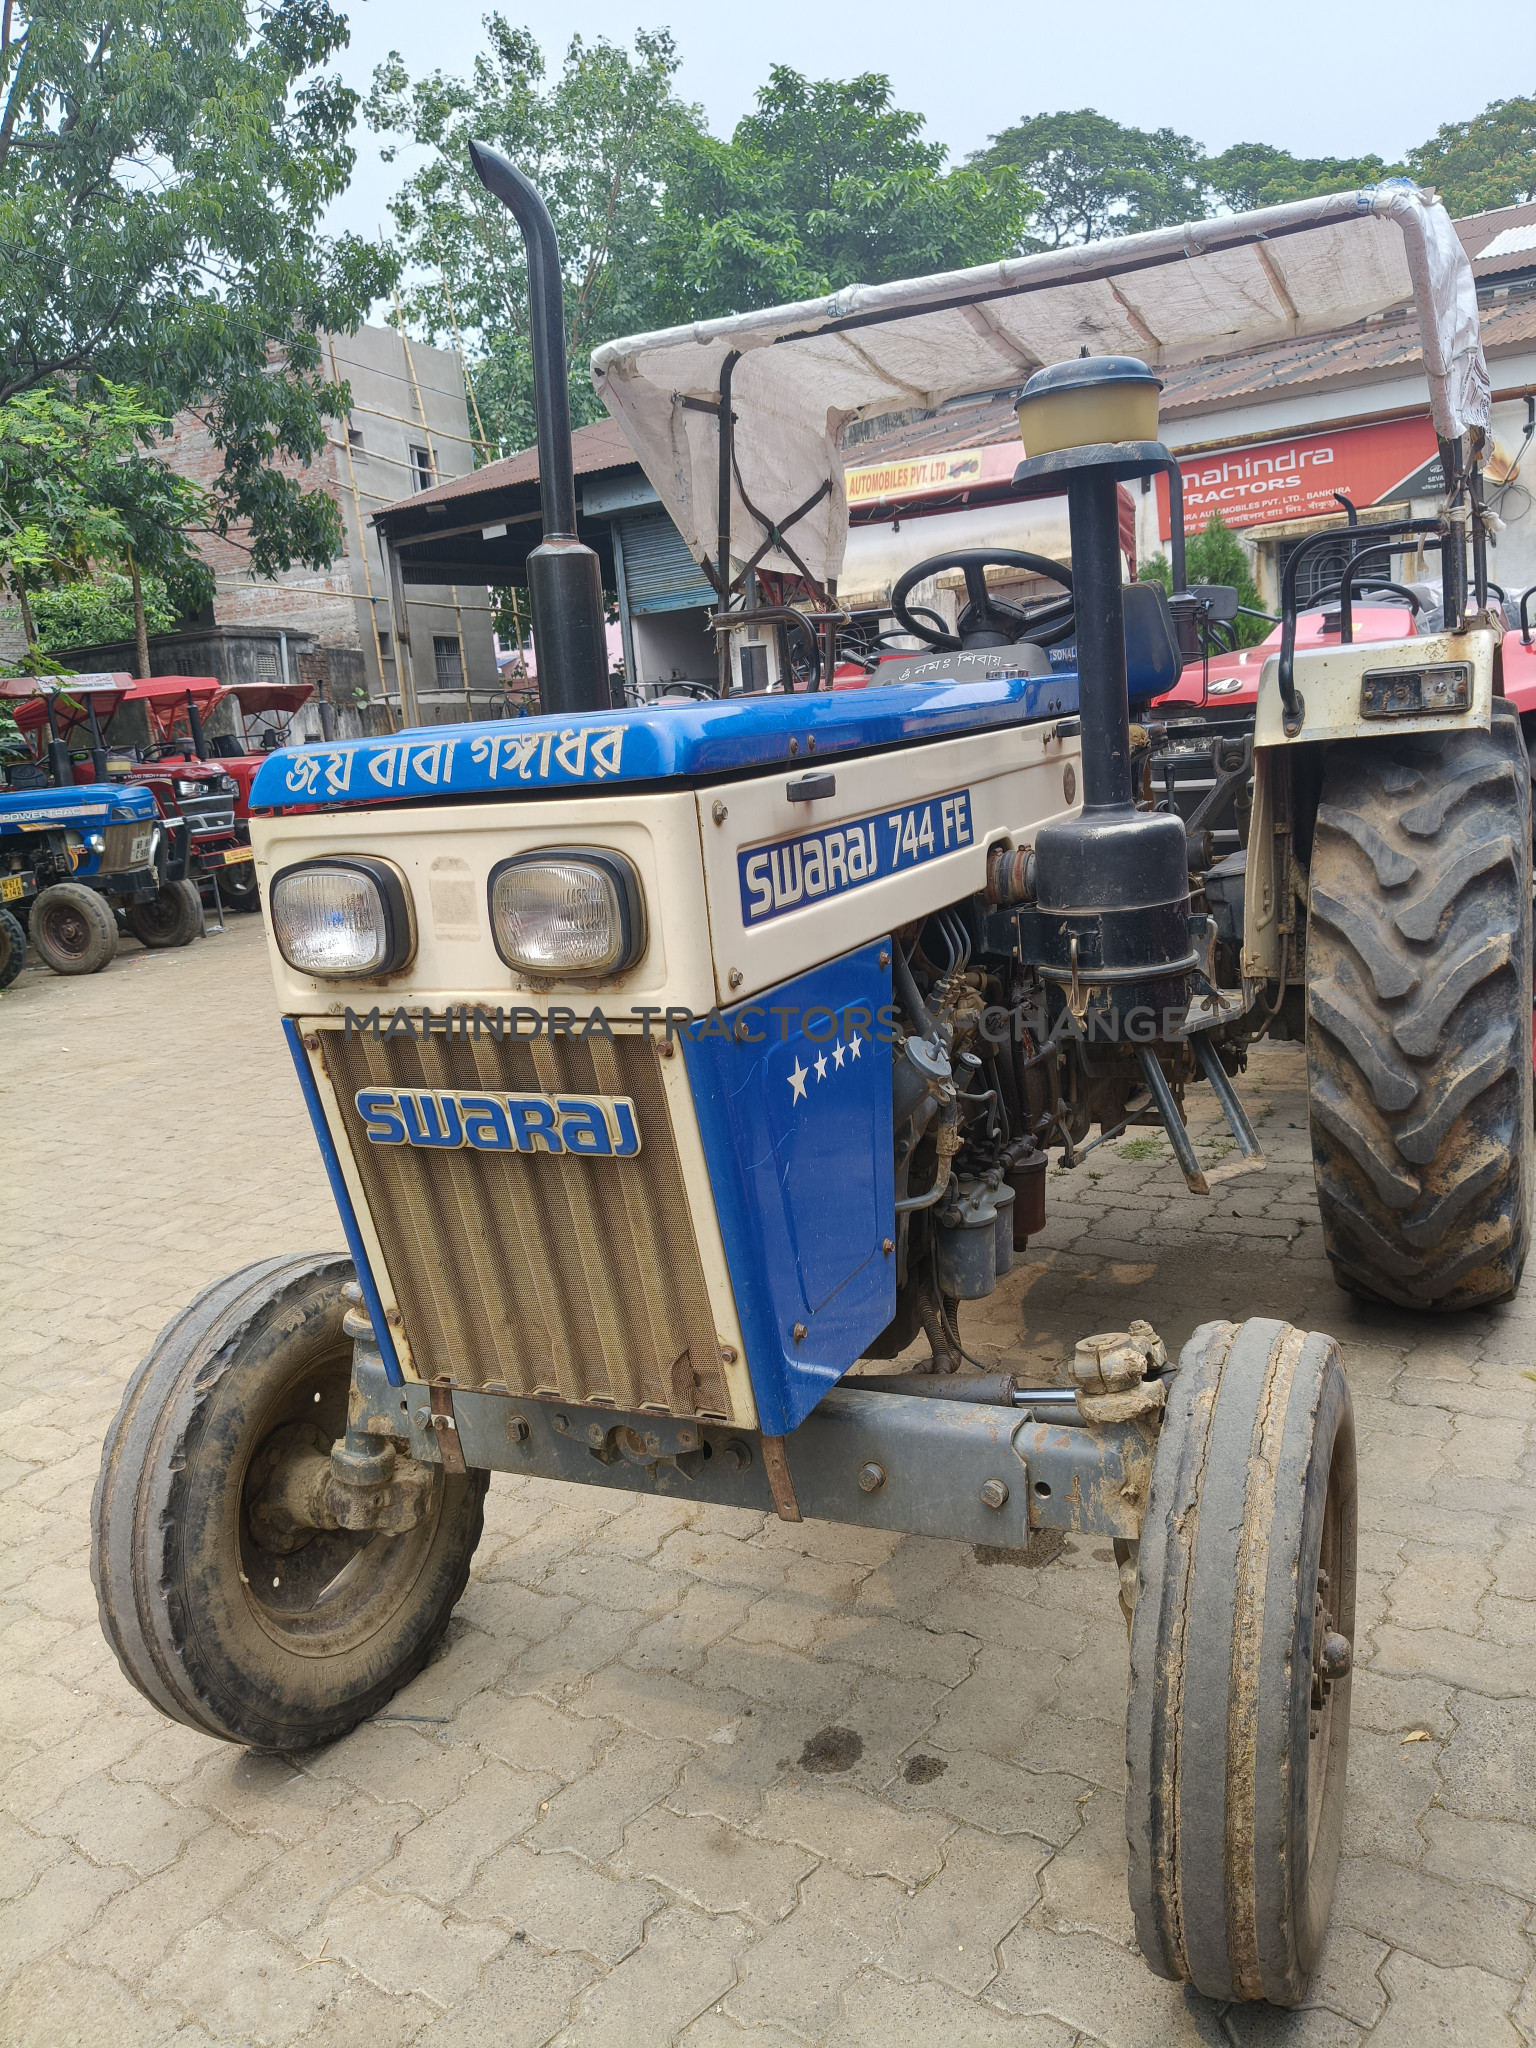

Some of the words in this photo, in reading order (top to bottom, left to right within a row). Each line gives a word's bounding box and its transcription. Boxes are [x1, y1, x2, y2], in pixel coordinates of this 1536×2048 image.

[849, 468, 908, 496] AUTOMOBILES
[910, 463, 928, 485] PVT.
[930, 461, 947, 481] LTD
[1306, 486, 1352, 500] BANKURA
[914, 658, 952, 675] নমঃ
[956, 651, 1002, 667] শিবায়
[285, 747, 359, 796] জয়
[367, 738, 461, 788] বাবা
[471, 724, 630, 780] গঙ্গাধর
[2, 807, 81, 821] POWERTRAC
[745, 821, 878, 919] SWARAJ
[888, 805, 935, 869] 744
[940, 794, 971, 849] FE
[355, 1089, 640, 1158] SWARAJ
